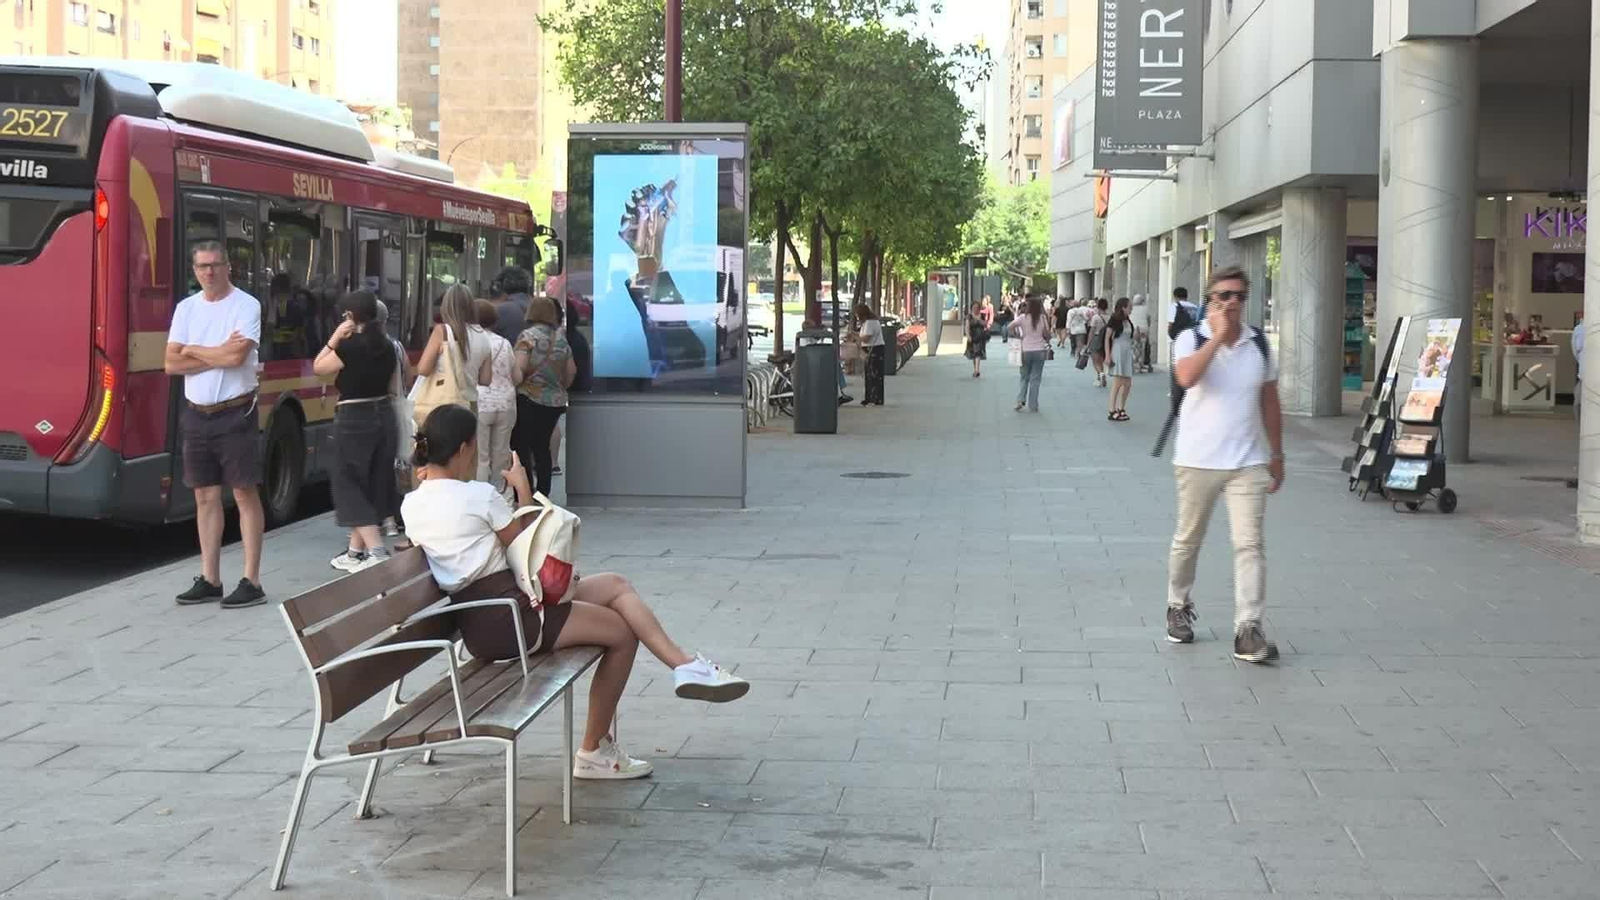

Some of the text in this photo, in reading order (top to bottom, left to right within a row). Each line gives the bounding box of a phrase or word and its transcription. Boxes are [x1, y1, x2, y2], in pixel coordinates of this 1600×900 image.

[1139, 0, 1184, 96] NER
[0, 108, 69, 137] 2527
[1138, 110, 1182, 120] PLAZA
[0, 160, 48, 179] villa
[293, 173, 334, 201] SEVILLA
